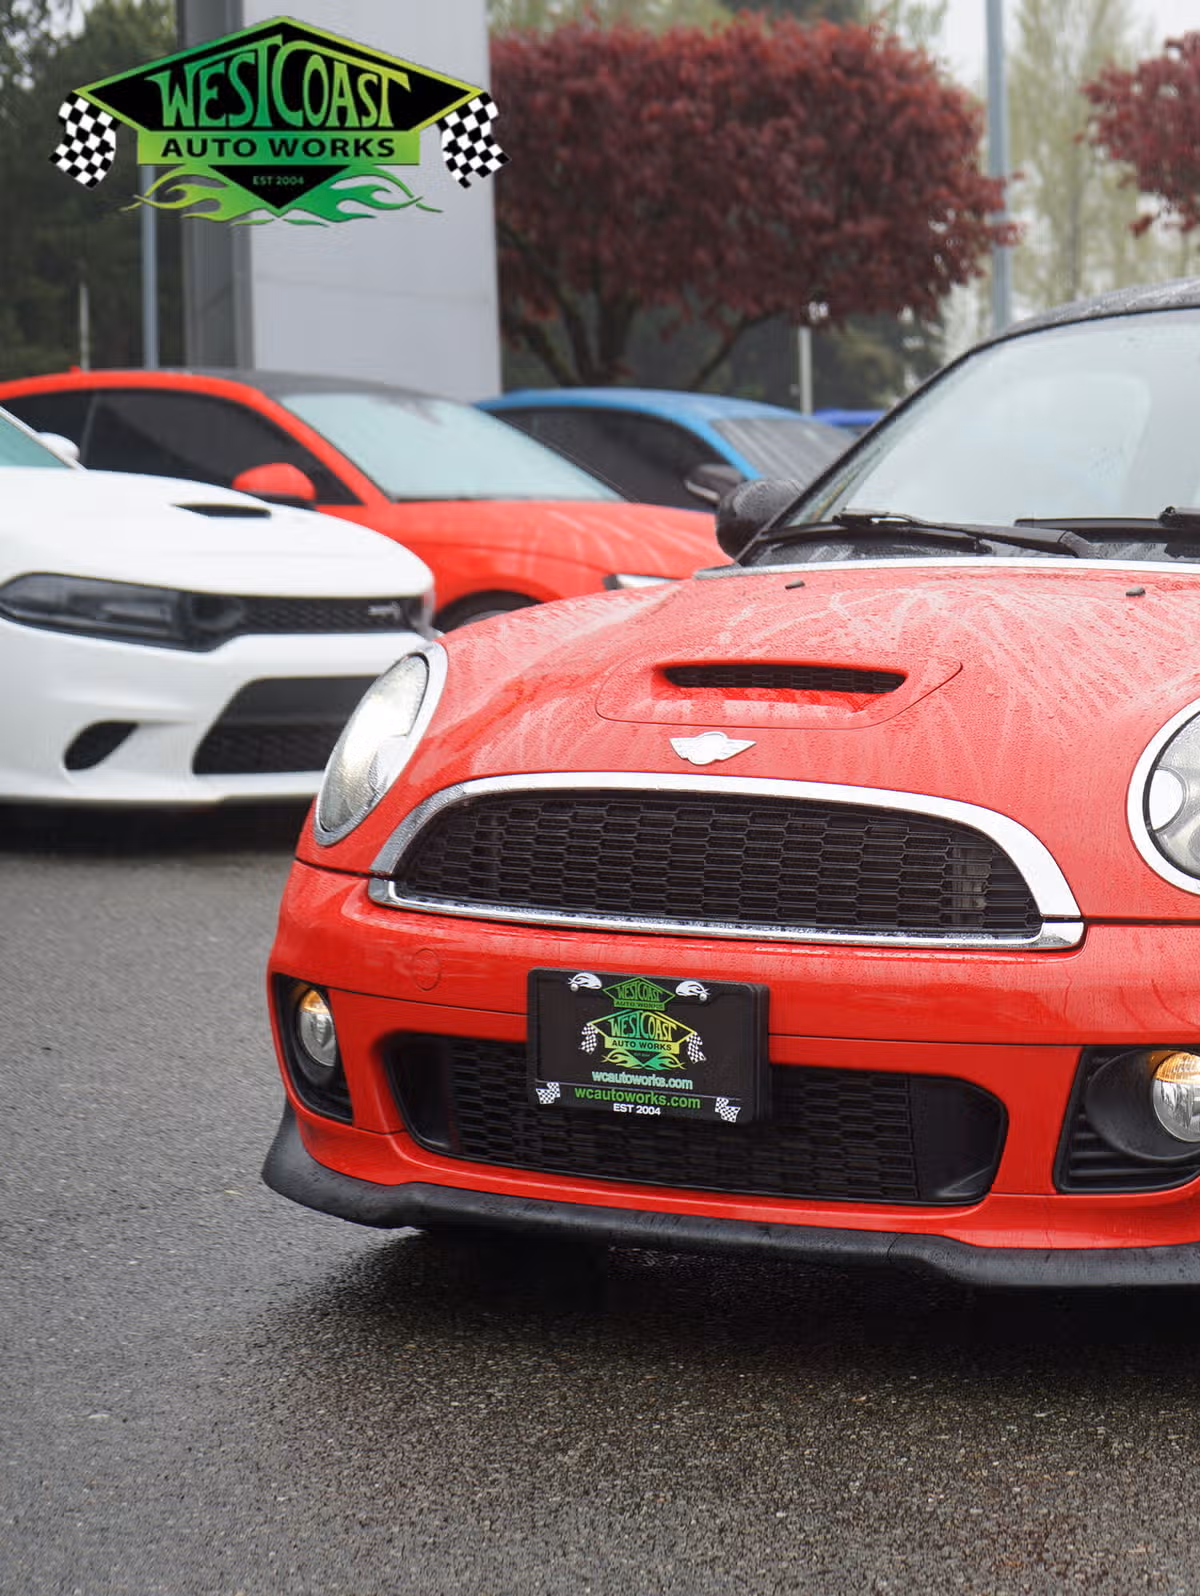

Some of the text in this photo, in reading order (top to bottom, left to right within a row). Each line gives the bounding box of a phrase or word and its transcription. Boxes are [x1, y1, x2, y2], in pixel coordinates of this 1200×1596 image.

[612, 1040, 672, 1051] AUTO WORKS
[591, 1071, 693, 1089] wcautoworks.com
[574, 1087, 701, 1109] wcautoworks.com
[612, 1102, 661, 1116] EST 2004
